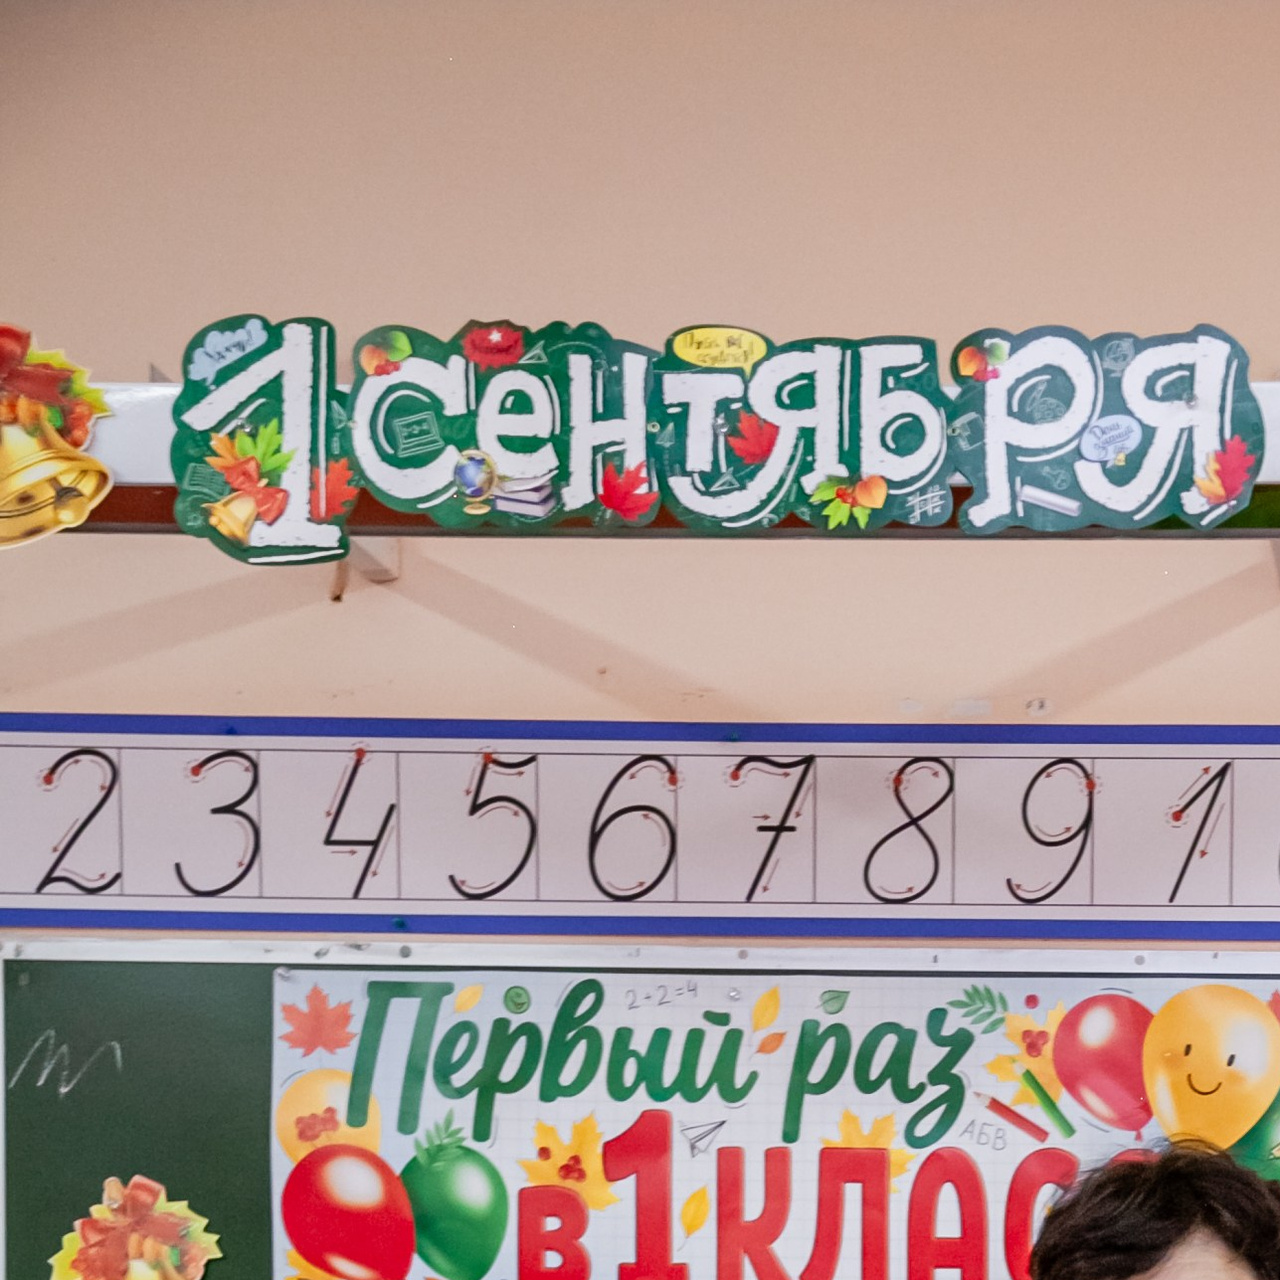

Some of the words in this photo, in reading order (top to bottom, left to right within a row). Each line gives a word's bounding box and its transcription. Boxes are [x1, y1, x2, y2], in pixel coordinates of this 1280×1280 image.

[345, 979, 761, 1144] Первый
[780, 1006, 977, 1149] раз
[959, 1119, 1008, 1151] АБВ
